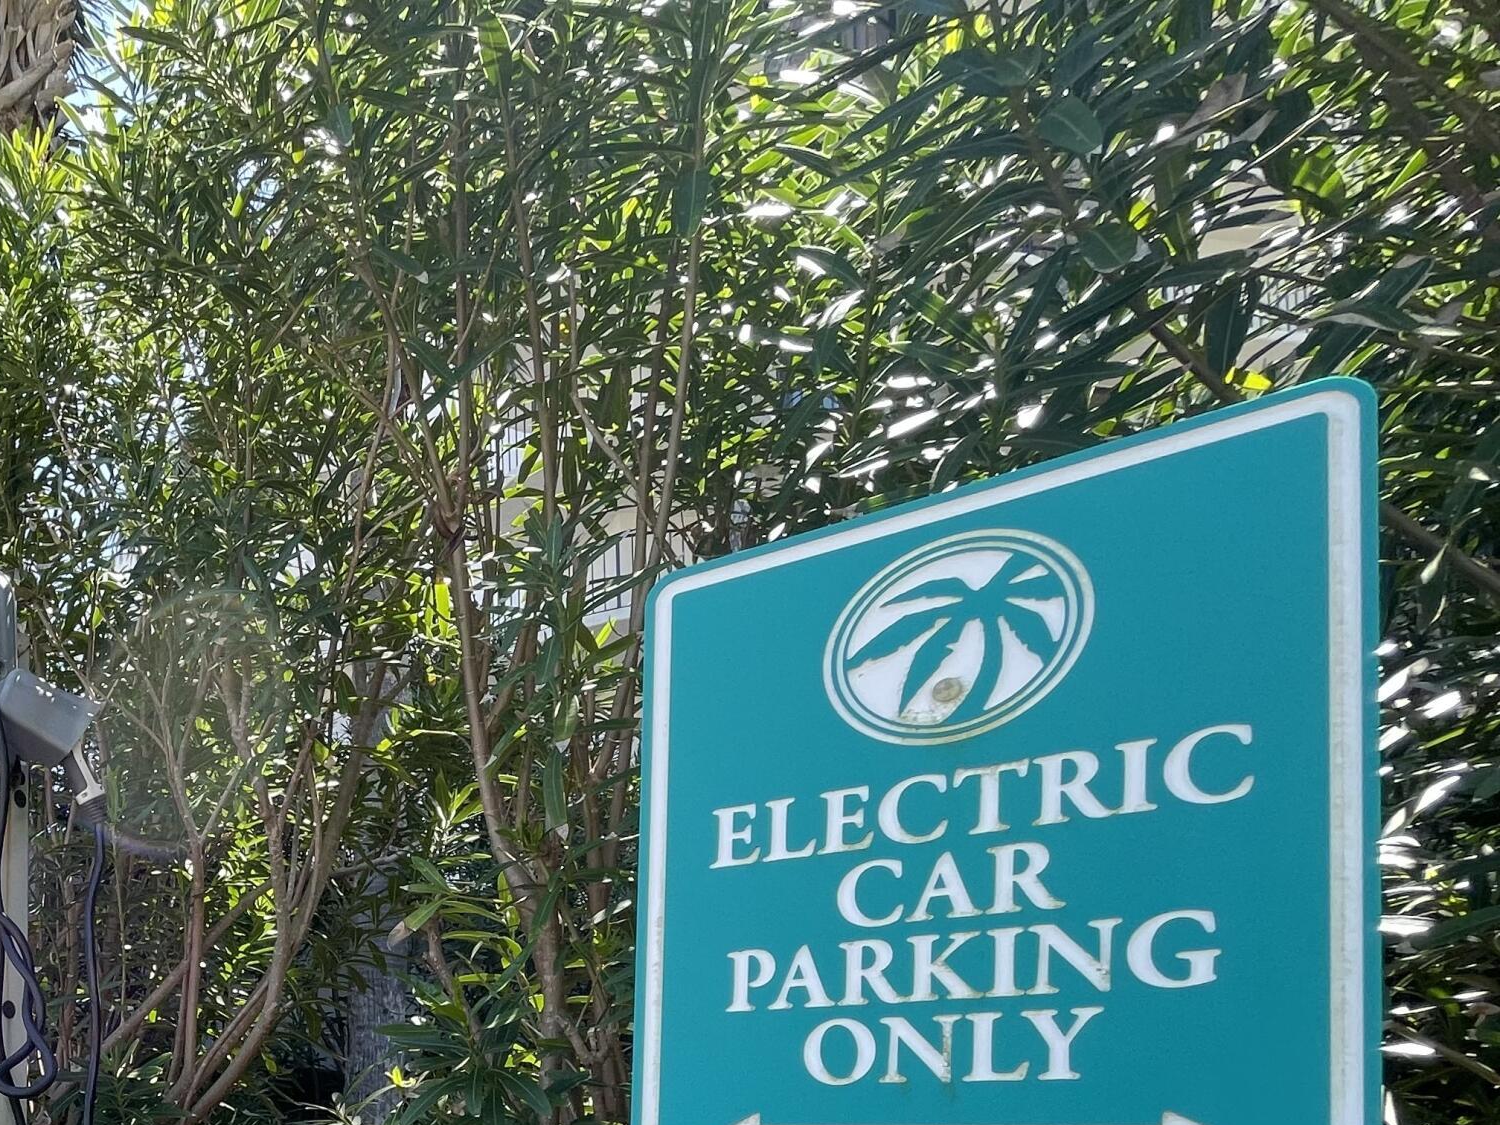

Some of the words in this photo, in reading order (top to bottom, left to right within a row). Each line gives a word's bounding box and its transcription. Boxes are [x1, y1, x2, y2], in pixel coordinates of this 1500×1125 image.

[709, 724, 1255, 869] ELECTRIC
[836, 842, 1066, 928] CAR
[725, 911, 1222, 1013] PARKING
[803, 1006, 1104, 1085] ONLY
